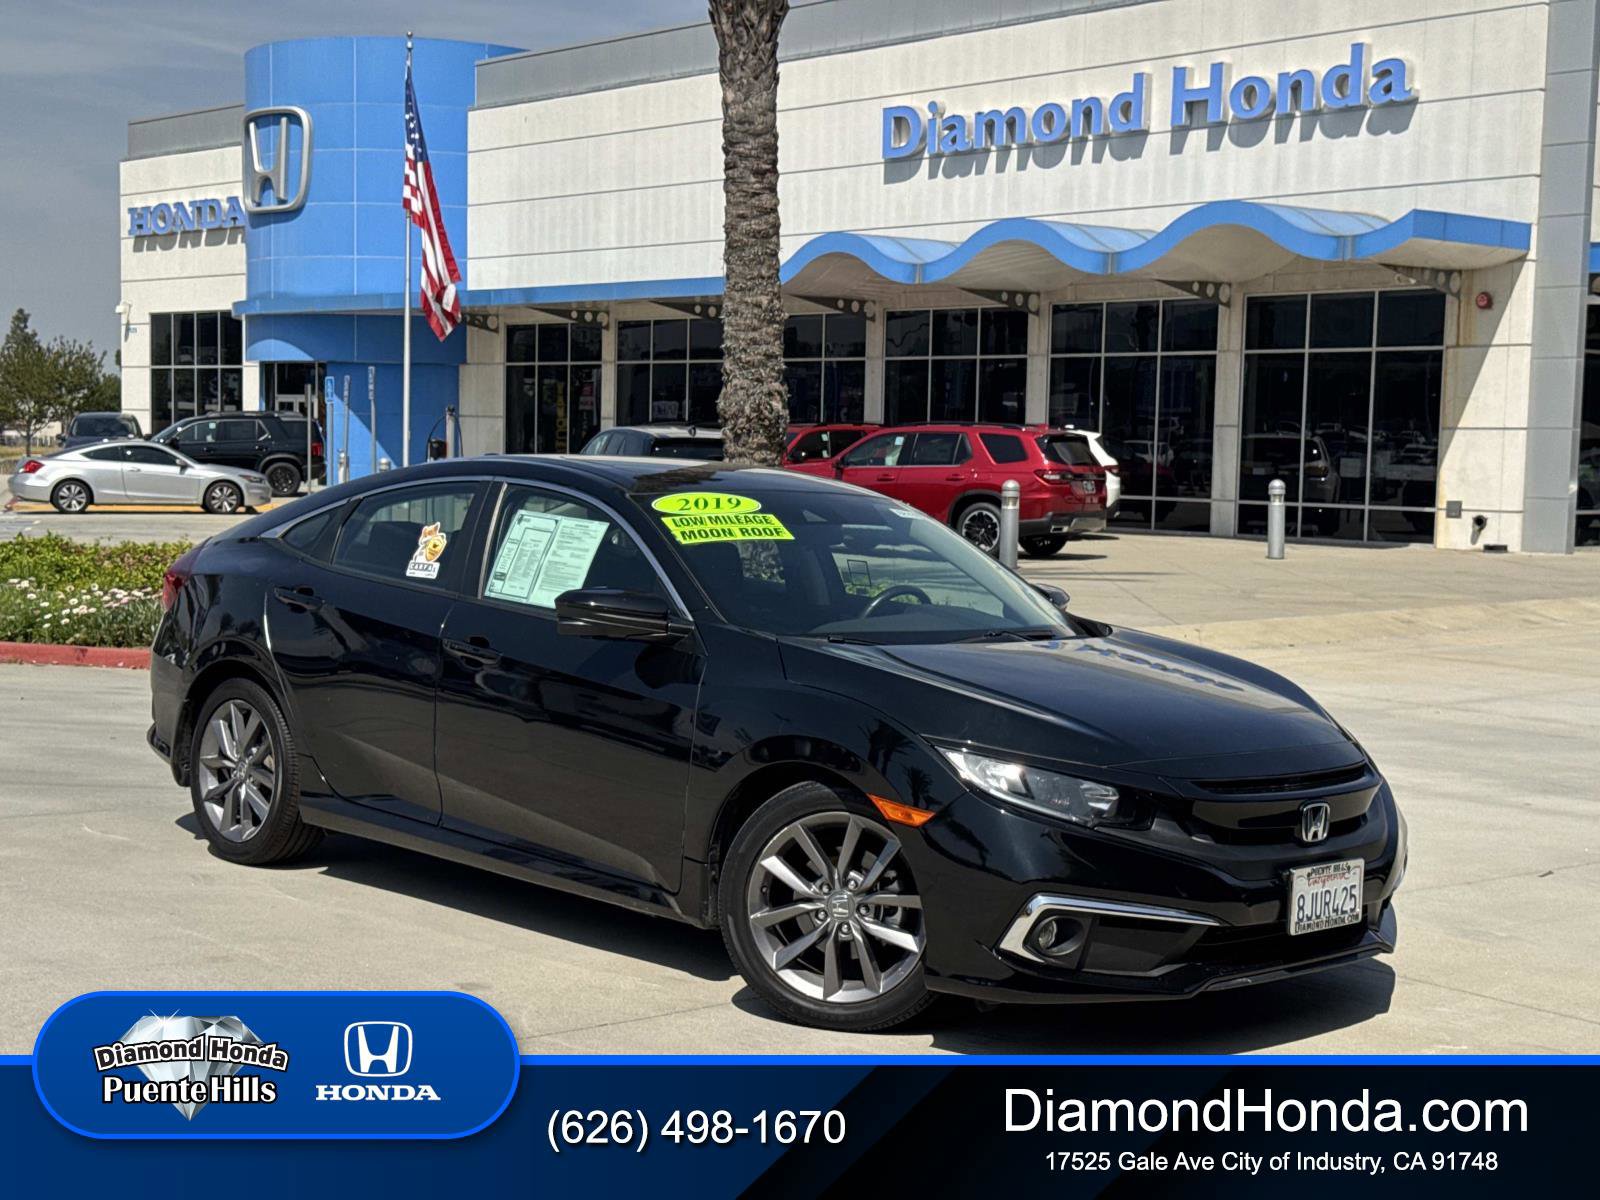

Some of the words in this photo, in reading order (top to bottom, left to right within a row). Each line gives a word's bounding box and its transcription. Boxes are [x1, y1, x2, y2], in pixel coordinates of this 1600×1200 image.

[882, 72, 1150, 159] Diamond
[1173, 42, 1416, 127] Honda
[127, 196, 246, 236] HONDA
[676, 497, 742, 511] 2019
[671, 517, 707, 528] LOW
[708, 514, 775, 527] MILEAGE
[681, 527, 735, 541] MOON
[738, 526, 785, 538] ROOF
[1296, 884, 1357, 923] 8JUR425
